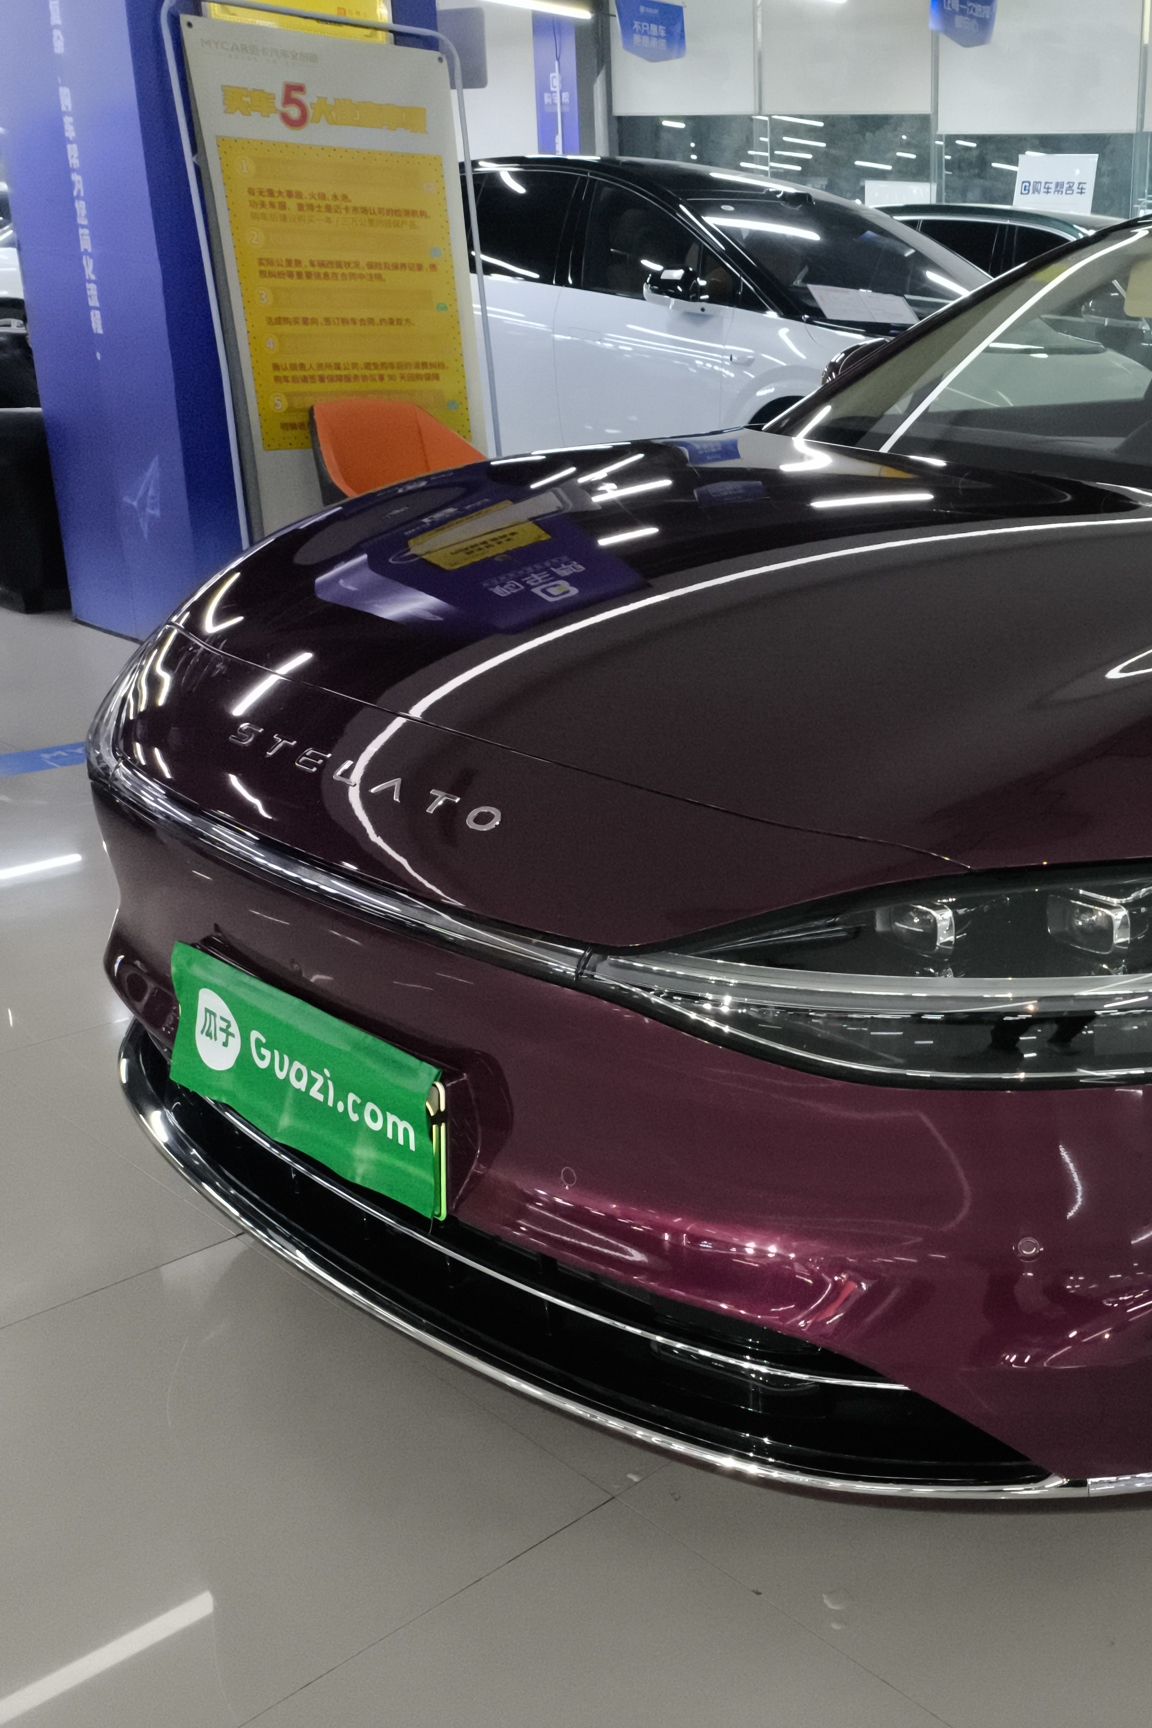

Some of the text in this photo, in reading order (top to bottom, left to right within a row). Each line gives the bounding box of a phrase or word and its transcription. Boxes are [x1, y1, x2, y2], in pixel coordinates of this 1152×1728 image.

[229, 722, 503, 832] STELATO
[201, 1007, 416, 1152] 瓜子 Guazi.com
